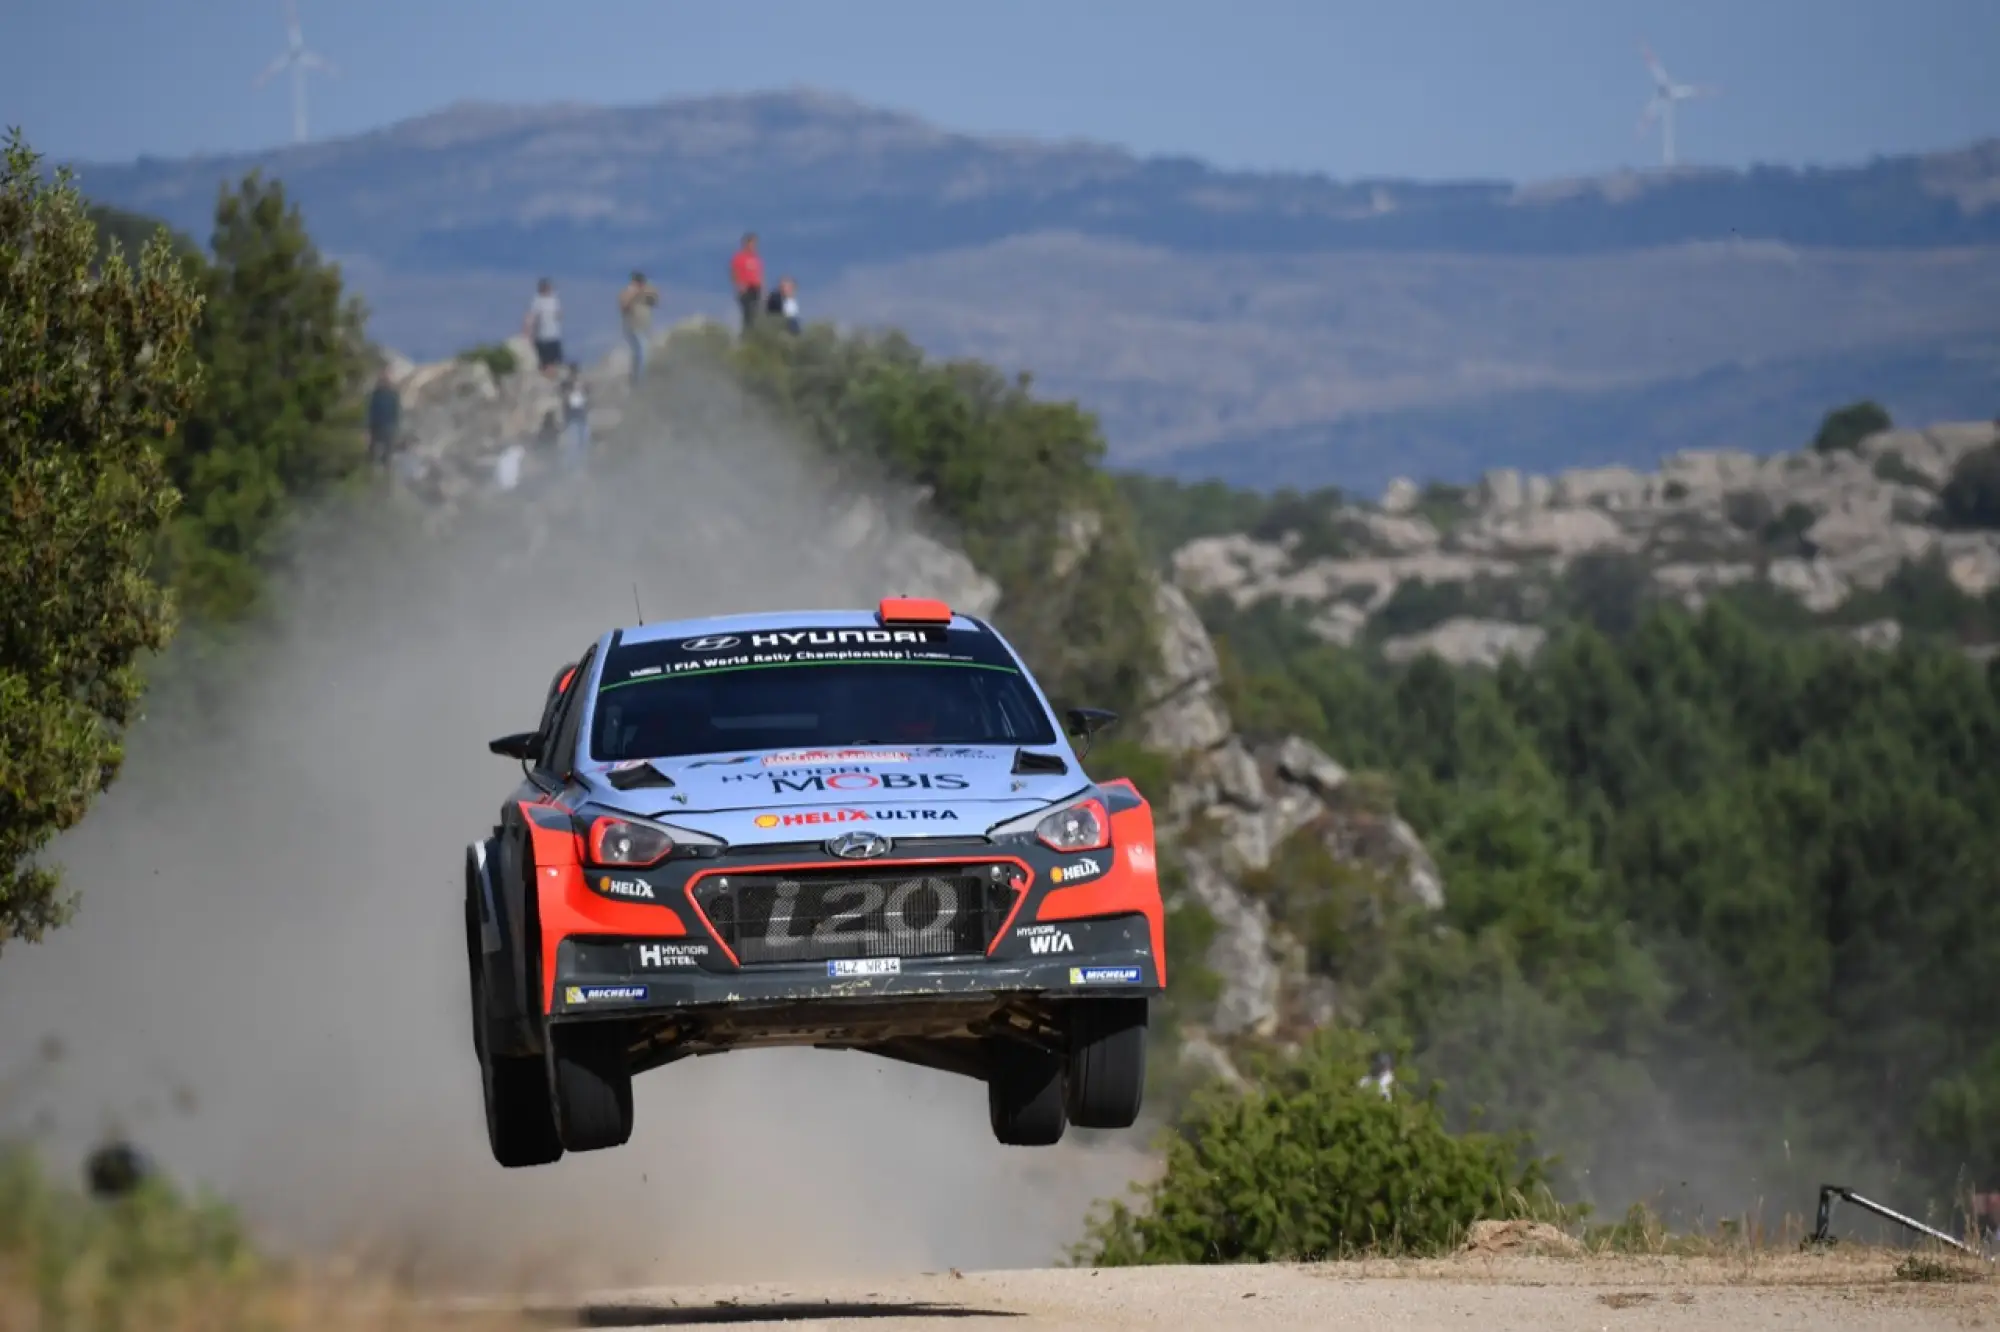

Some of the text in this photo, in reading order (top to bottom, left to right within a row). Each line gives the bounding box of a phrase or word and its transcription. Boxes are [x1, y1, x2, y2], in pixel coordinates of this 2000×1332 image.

[752, 630, 927, 647] HYUNDAI
[674, 660, 700, 672] FIA
[703, 655, 749, 668] World
[754, 652, 792, 663] Rally
[796, 648, 903, 661] Championship
[721, 766, 871, 783] HYUNDAI
[772, 772, 970, 794] MOBIS
[783, 807, 959, 827] HELIX ULTRA
[1063, 858, 1101, 881] HELIX
[610, 878, 655, 899] HELIX
[764, 877, 959, 947] i20
[662, 945, 709, 956] HYUNDAI
[663, 956, 698, 966] STEEL
[1085, 969, 1138, 980] MICHELIN
[587, 987, 645, 999] MICHELIN
